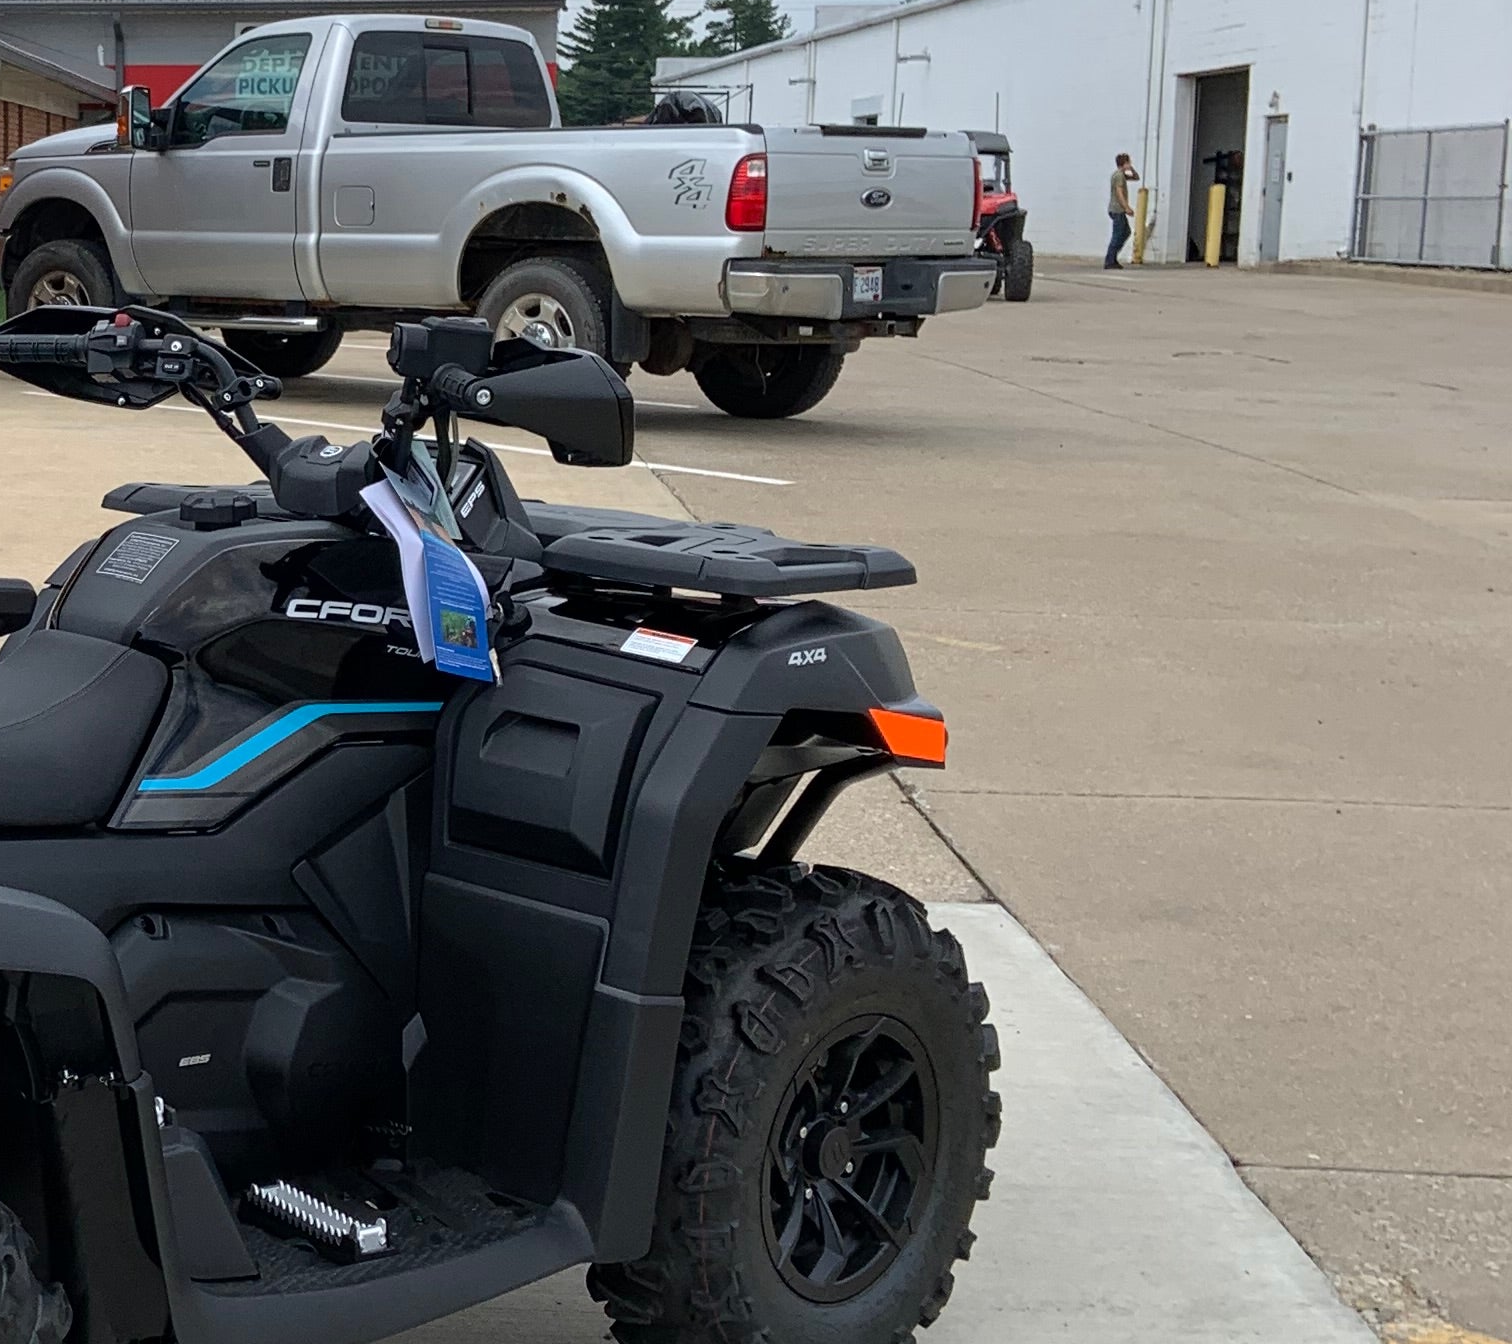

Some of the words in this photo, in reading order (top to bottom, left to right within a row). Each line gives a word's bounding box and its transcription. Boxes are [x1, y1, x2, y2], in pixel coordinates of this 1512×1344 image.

[460, 480, 486, 519] EPS
[286, 598, 412, 629] CFOR
[386, 644, 421, 659] TOU
